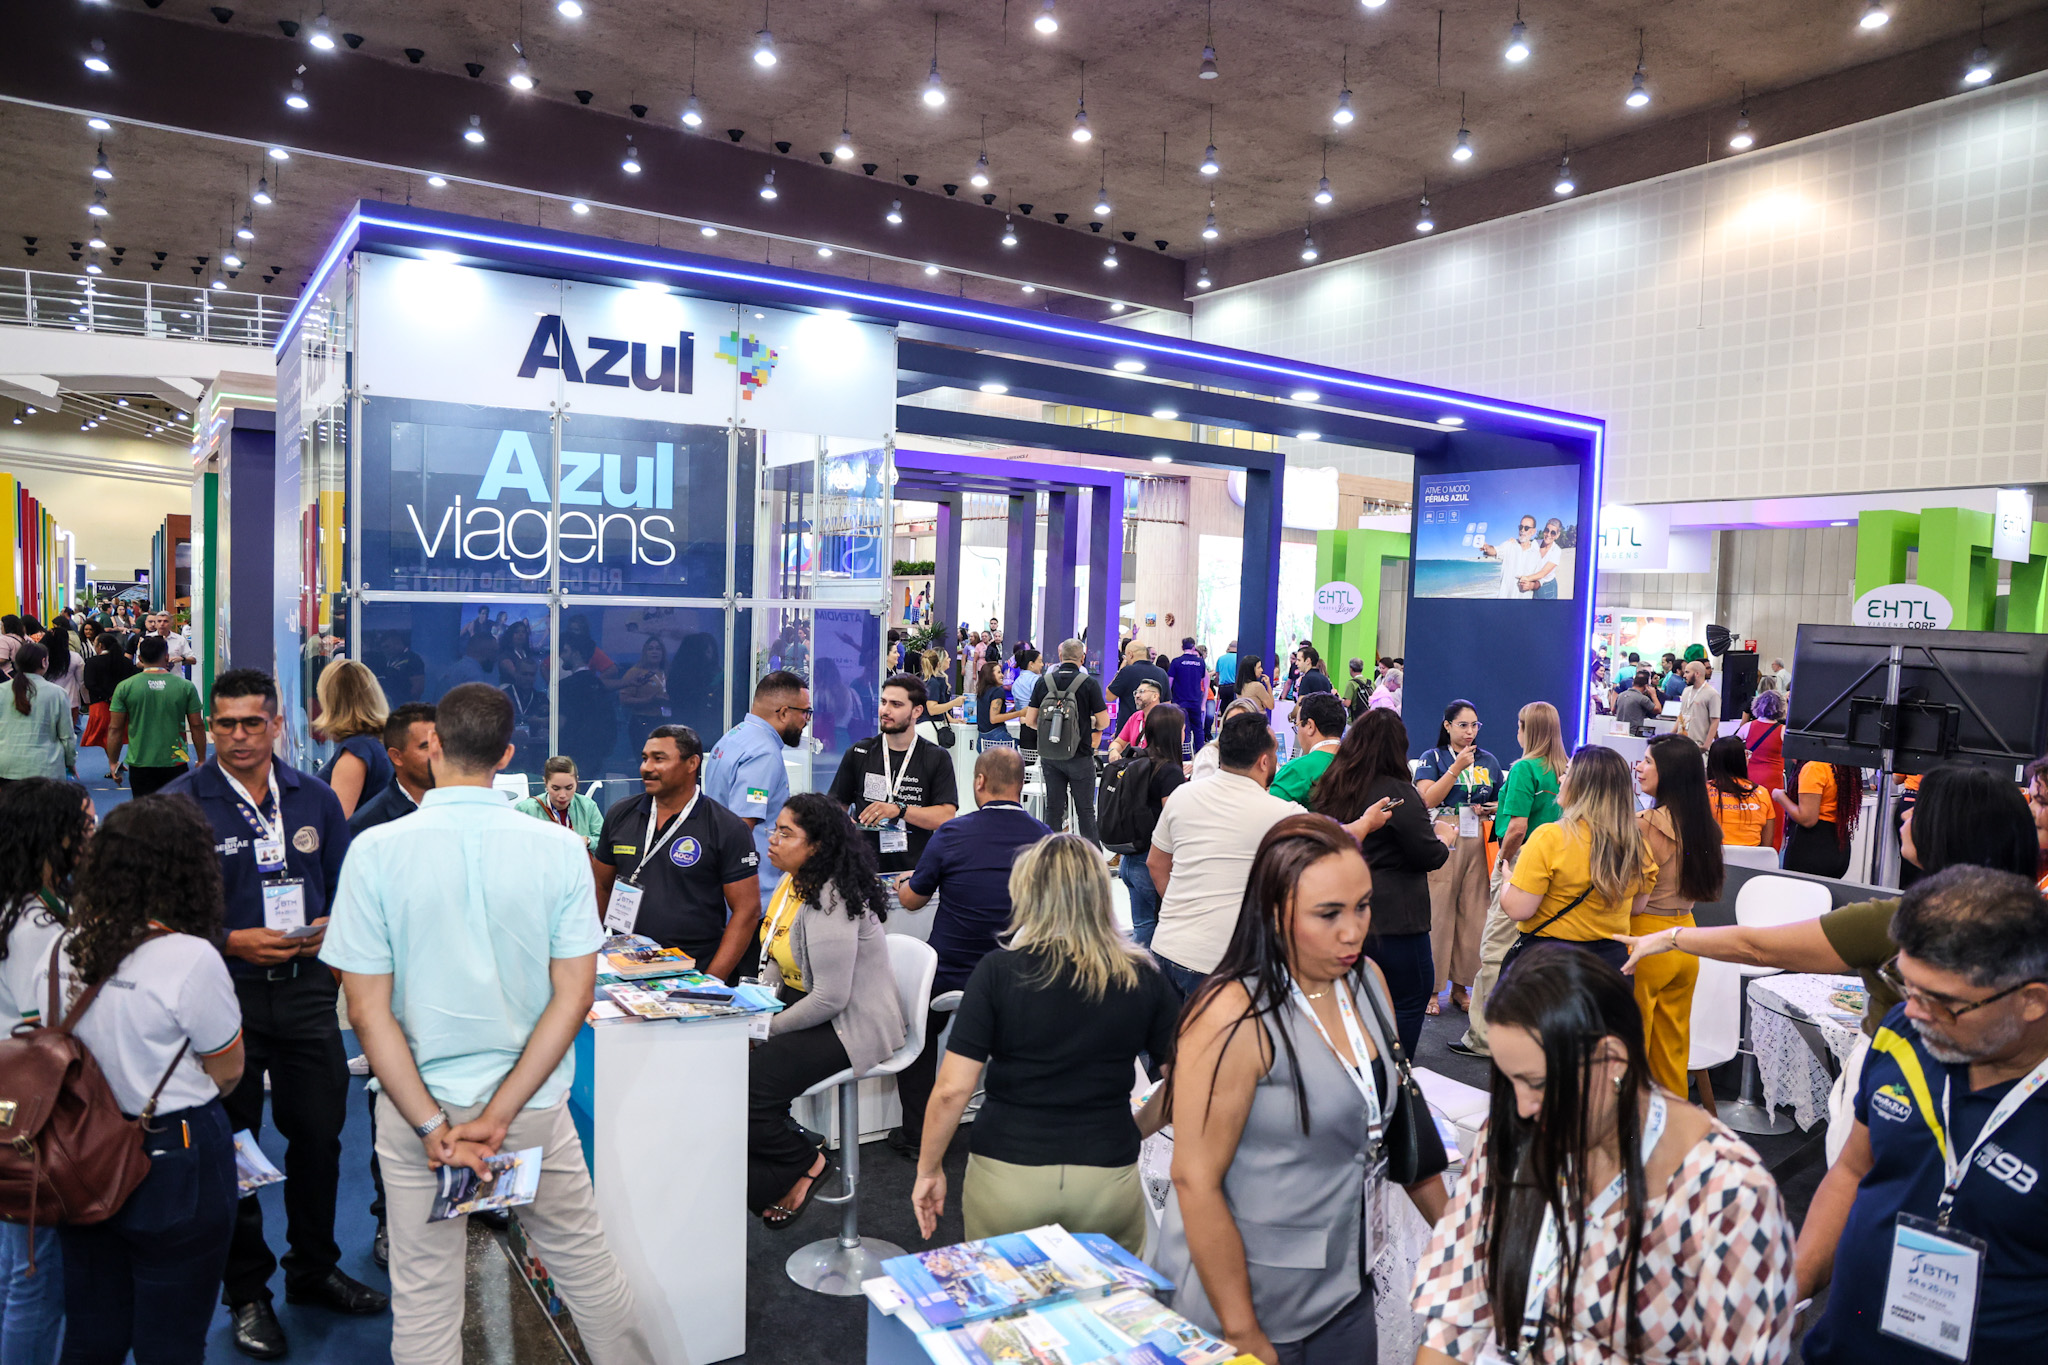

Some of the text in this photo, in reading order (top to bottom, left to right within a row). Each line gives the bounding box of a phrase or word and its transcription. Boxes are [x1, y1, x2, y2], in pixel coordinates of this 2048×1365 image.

[517, 314, 694, 394] Azul
[476, 429, 674, 509] Azul
[1442, 485, 1448, 493] O
[1449, 484, 1470, 493] MODO
[1425, 493, 1470, 503] FÉRIAS AZUL
[406, 495, 676, 579] viagens
[1599, 527, 1642, 546] HTL
[98, 583, 116, 591] TAUÁ
[1318, 590, 1354, 605] EHTL
[1867, 600, 1936, 620] EHTL
[1907, 621, 1936, 630] CORP
[901, 775, 918, 783] nforto
[900, 784, 922, 793] gurança
[898, 793, 916, 801] luções
[1922, 1263, 1959, 1285] BTM
